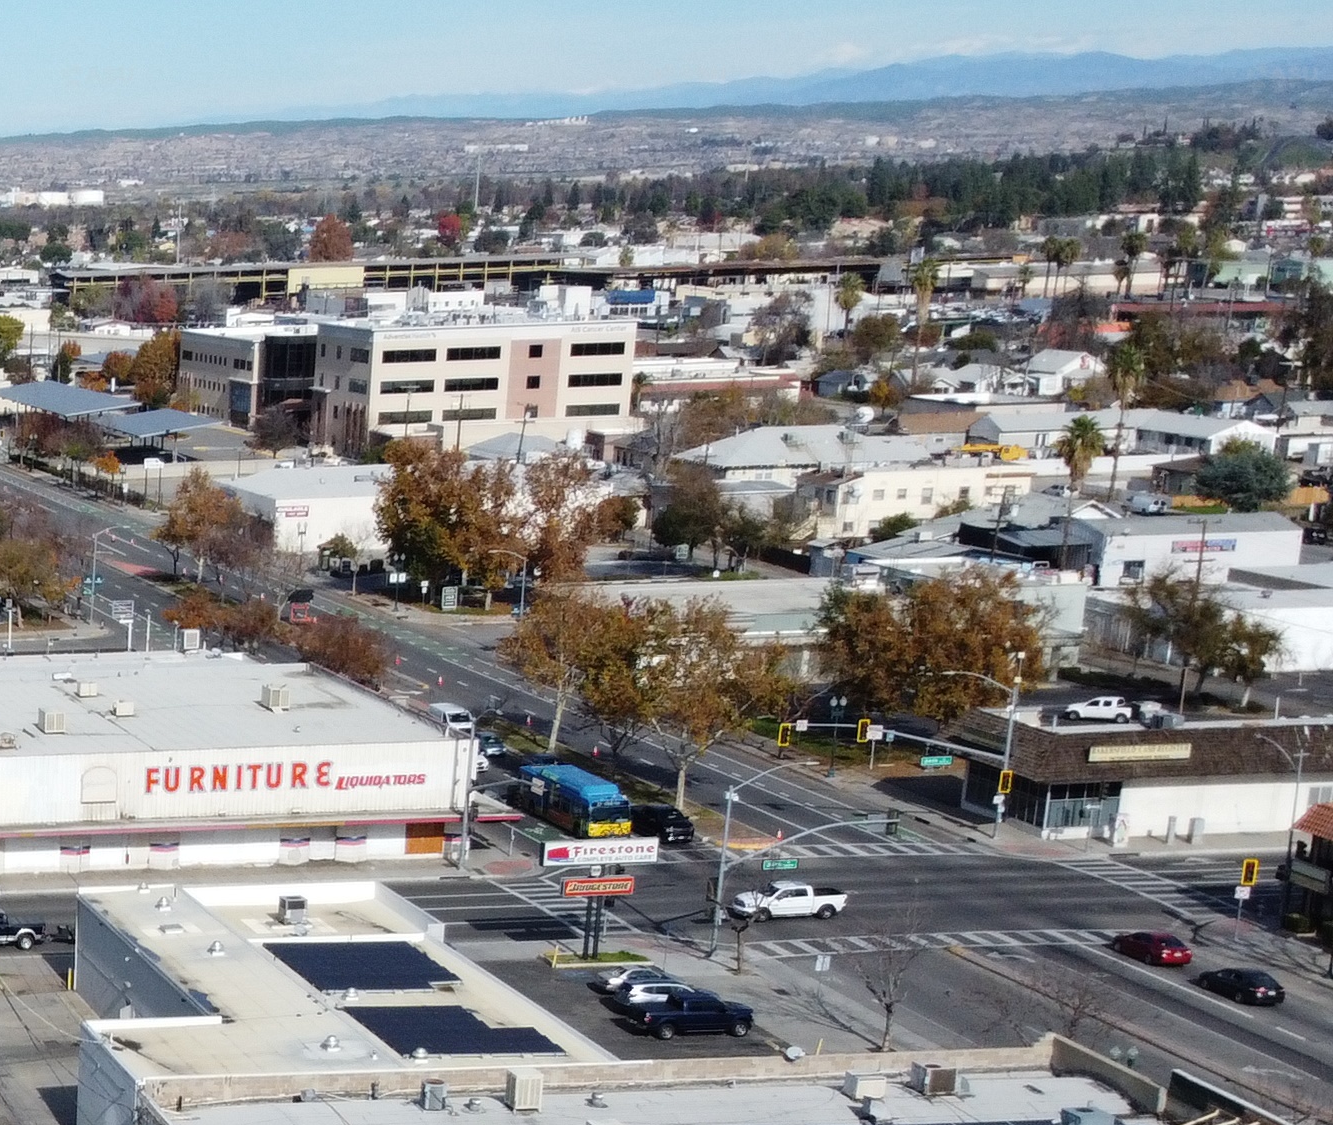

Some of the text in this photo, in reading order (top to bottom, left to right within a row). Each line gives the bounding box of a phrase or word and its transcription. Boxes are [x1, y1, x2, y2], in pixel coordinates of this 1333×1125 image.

[145, 761, 426, 794] FURNITURE LIQUIDATORS
[573, 845, 655, 858] Firestone
[569, 881, 631, 892] BRIDGESTONE
